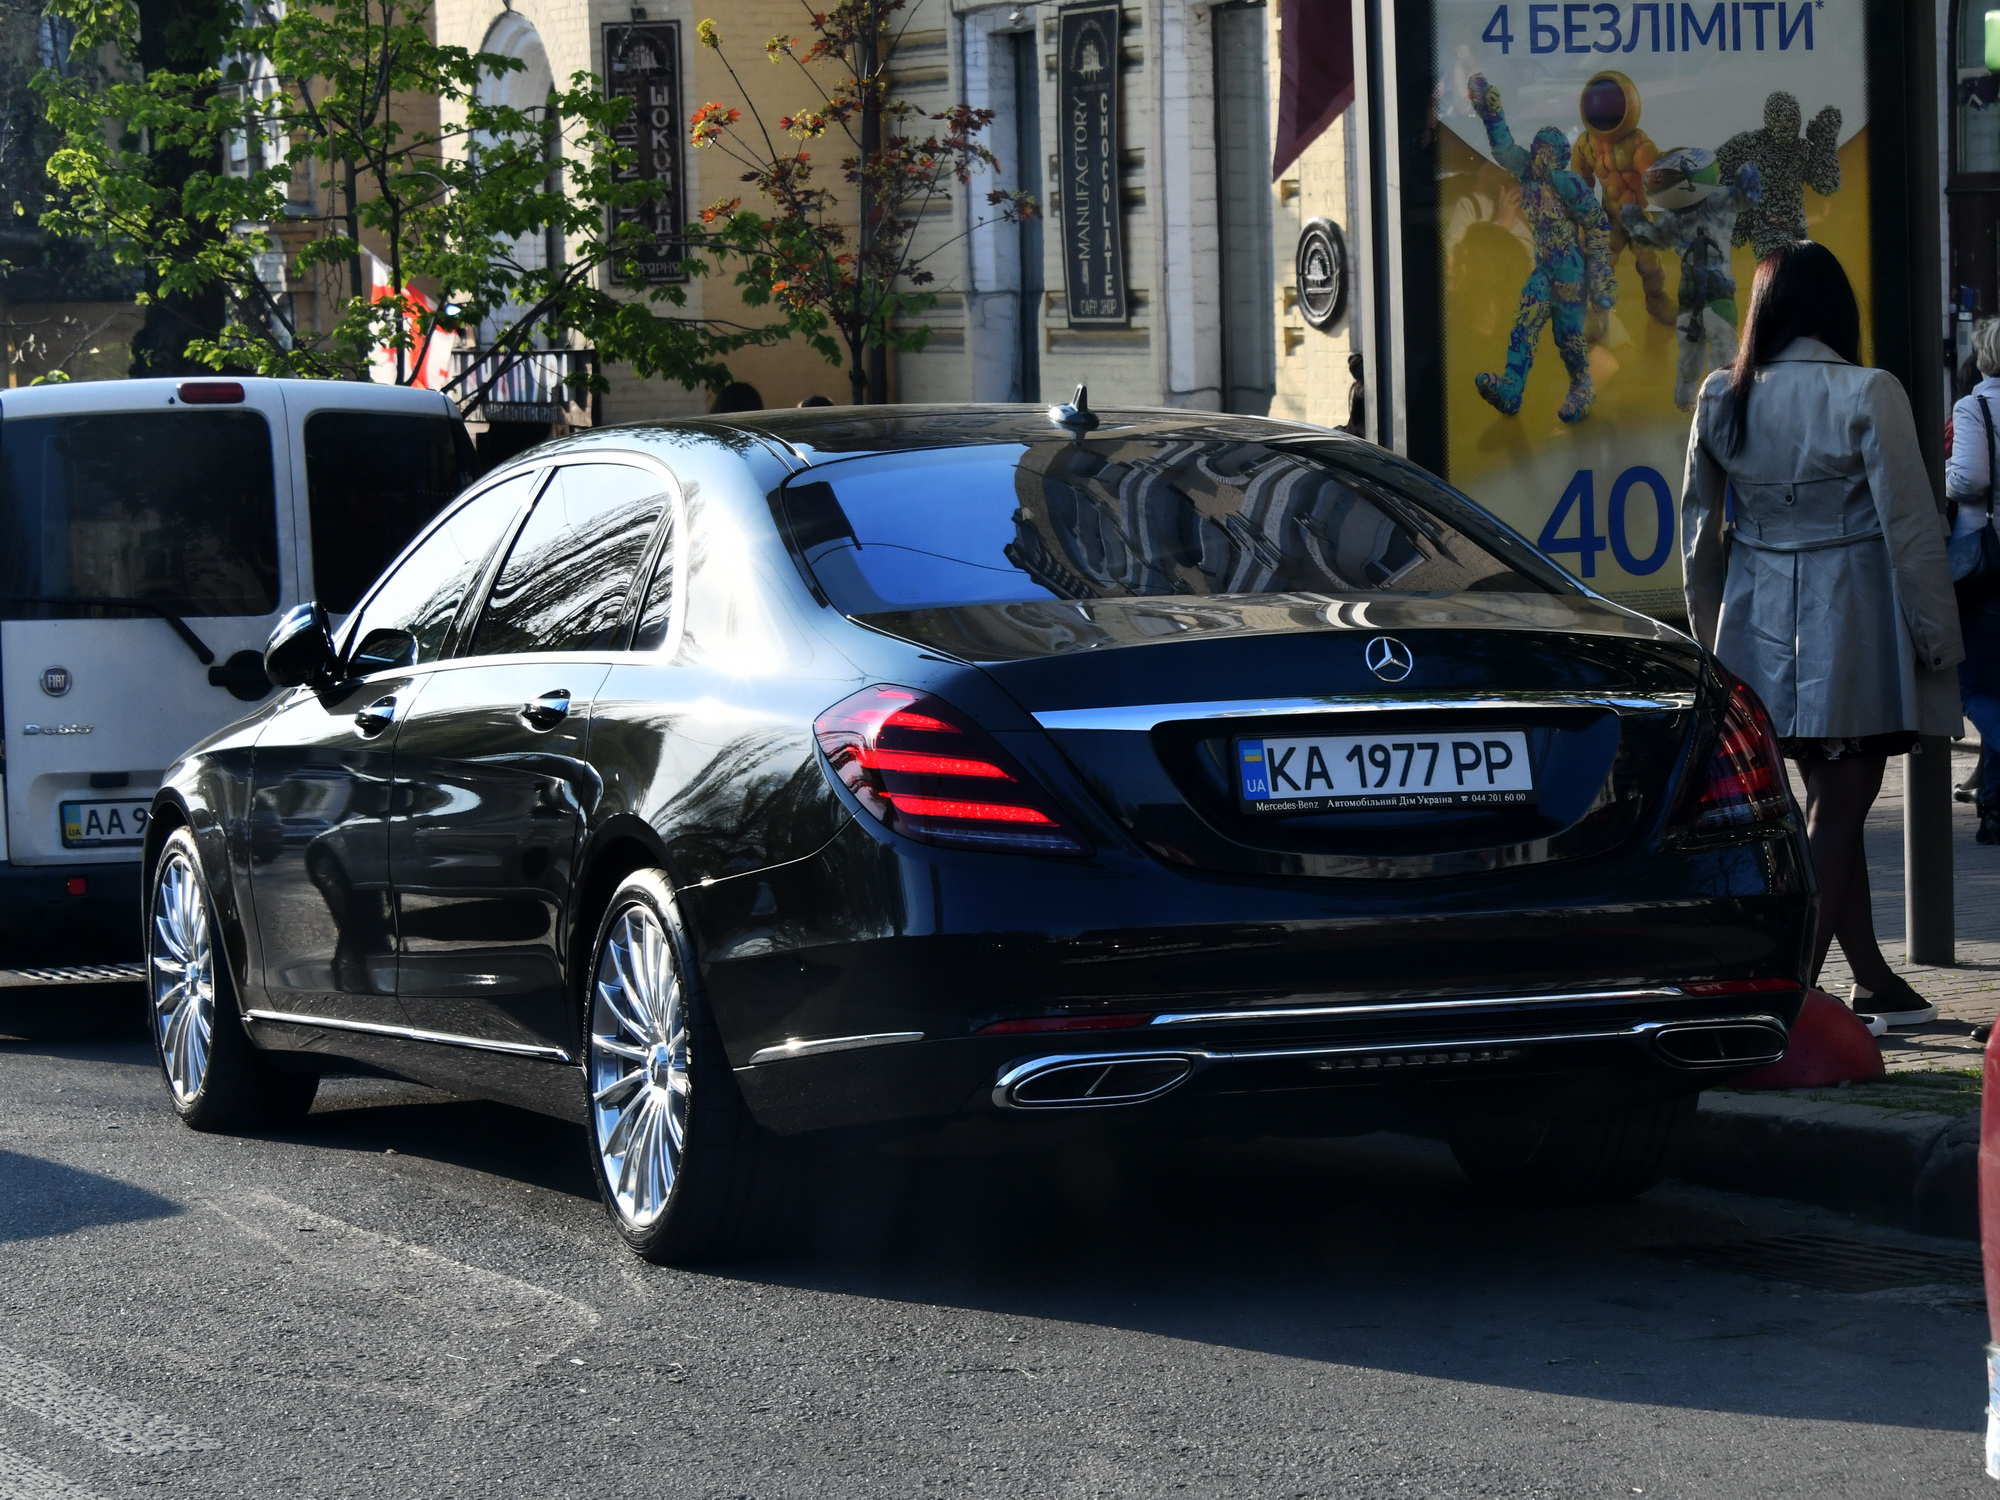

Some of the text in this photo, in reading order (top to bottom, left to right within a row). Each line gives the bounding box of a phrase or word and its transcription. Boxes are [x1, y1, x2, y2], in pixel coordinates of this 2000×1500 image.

[1482, 4, 1514, 54] 4
[1073, 96, 1091, 260] MANUFACTORY
[1100, 92, 1114, 297] CHOCOLATE
[1101, 299, 1117, 315] SHOP
[1537, 465, 1675, 578] 40
[48, 674, 66, 688] FIAT
[1266, 741, 1513, 792] KA 1977 PP
[1246, 779, 1267, 793] UA
[1256, 792, 1526, 812] Mercedes-Benz Автомобільний Дім Україна 044 201 60 00
[68, 828, 81, 836] UA
[85, 808, 125, 836] AA
